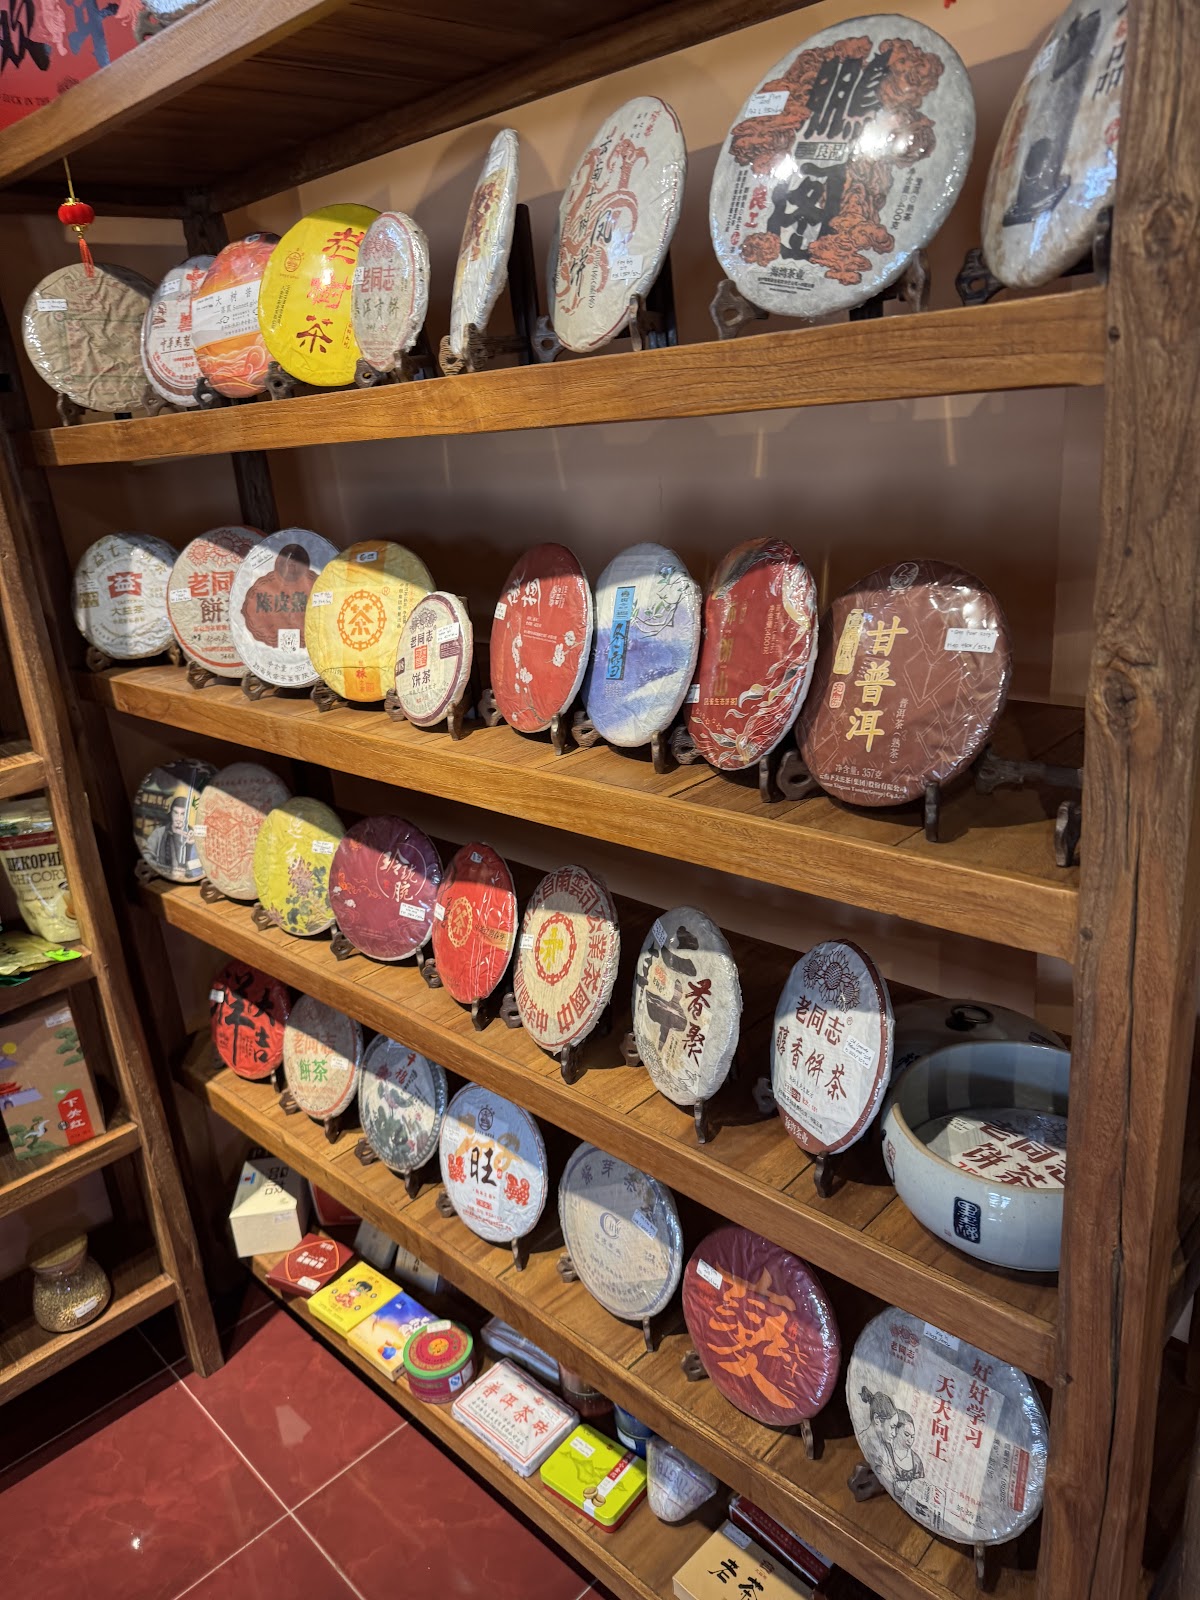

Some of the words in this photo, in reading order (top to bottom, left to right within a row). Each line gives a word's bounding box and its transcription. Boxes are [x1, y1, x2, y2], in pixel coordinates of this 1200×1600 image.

[845, 615, 909, 753] 甘普洱
[795, 994, 847, 1047] 老同志
[470, 1146, 498, 1187] 旺
[482, 1381, 550, 1438] 普洱茶砖
[929, 1373, 956, 1463] 天天向上
[965, 1358, 993, 1449] 好好学习
